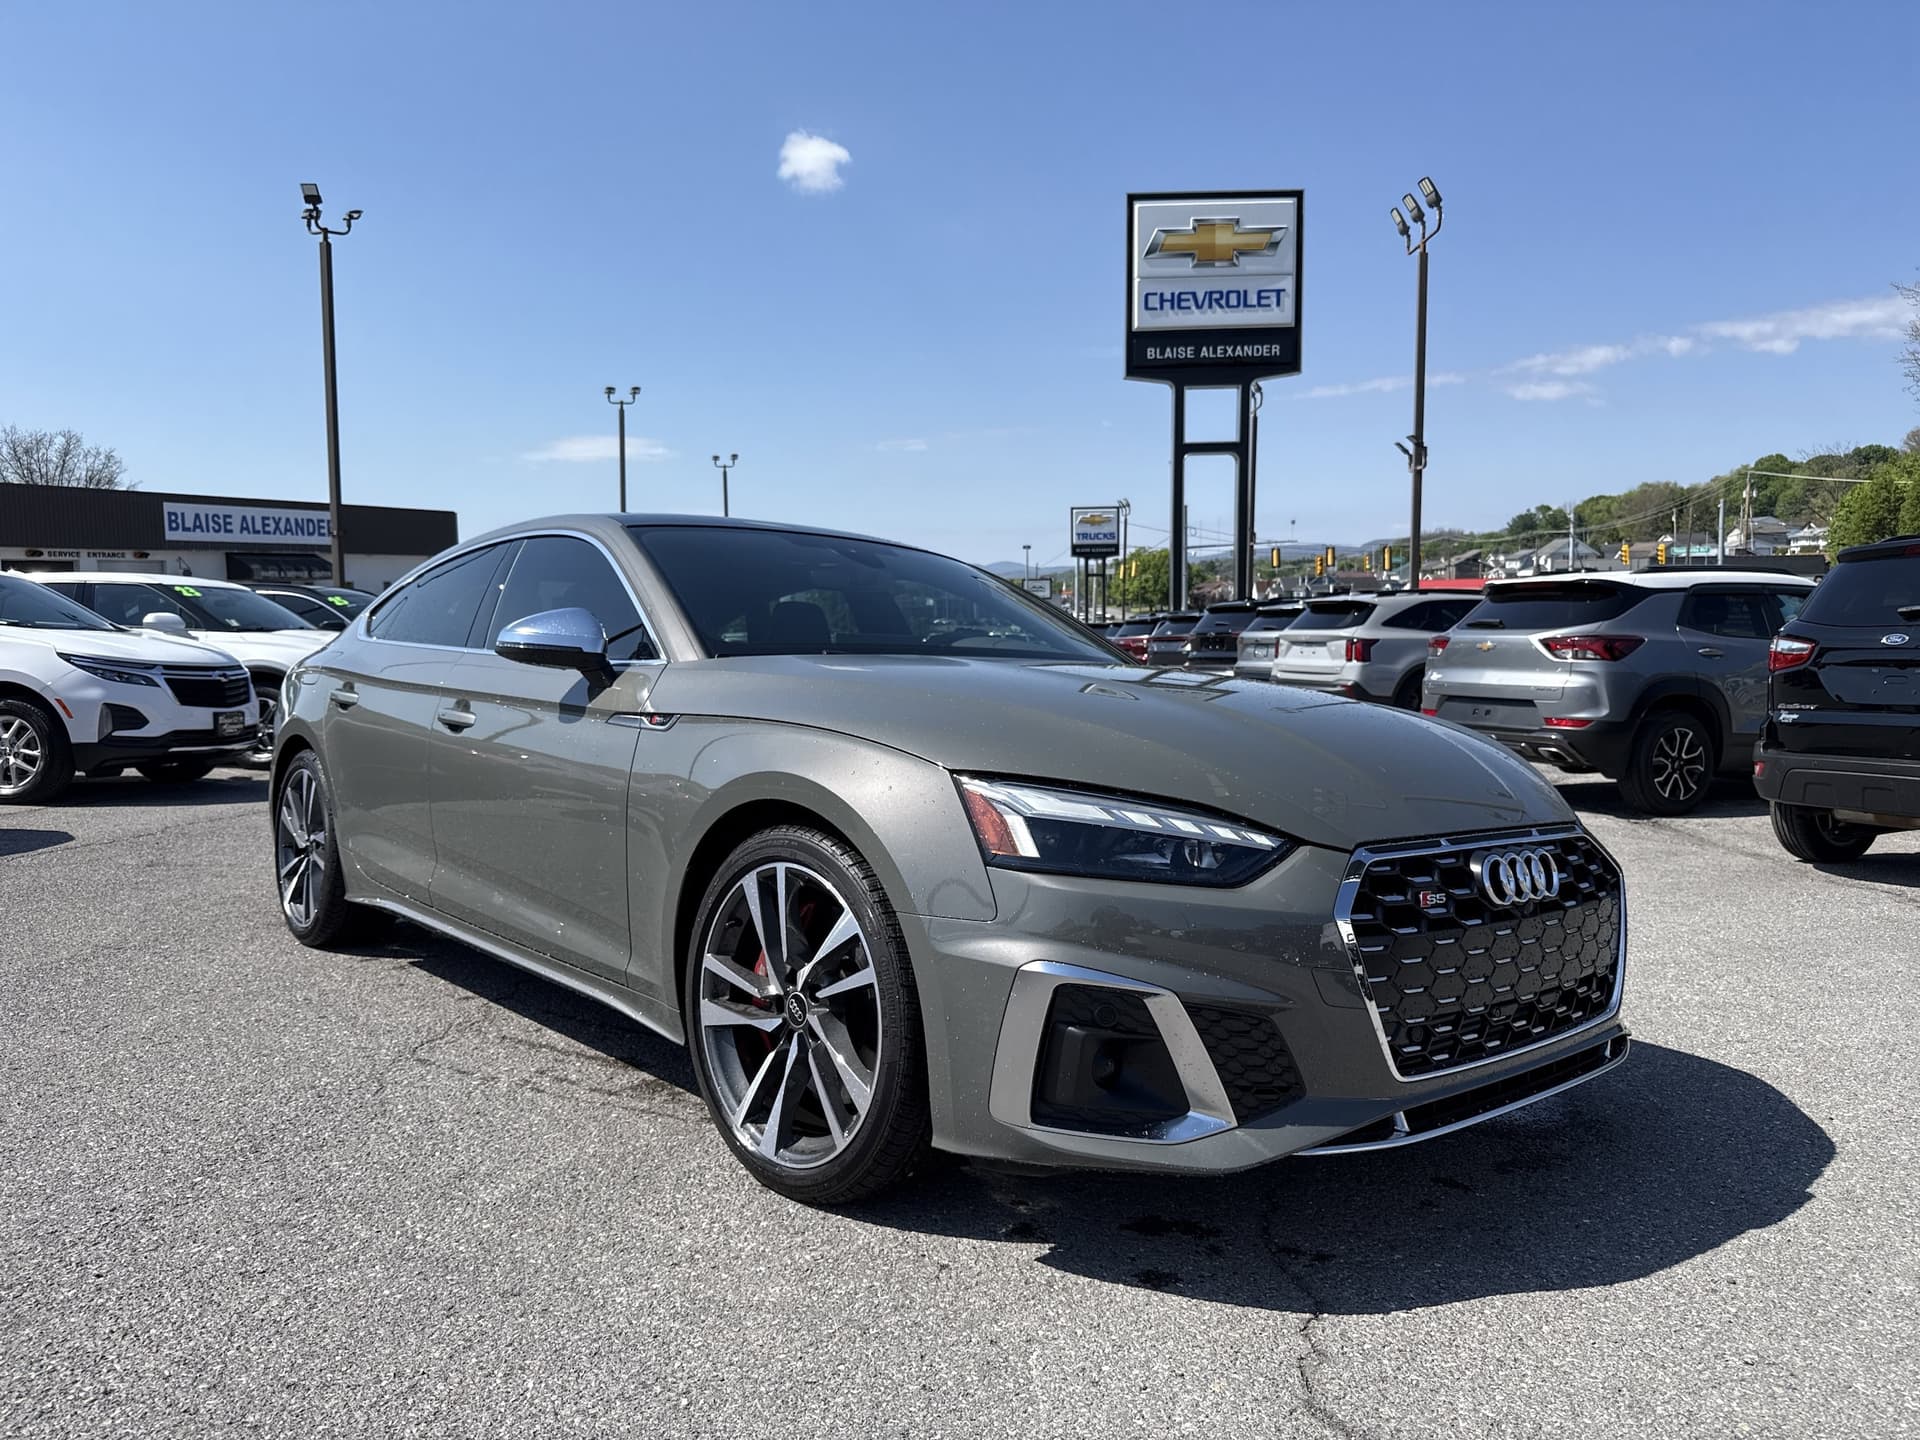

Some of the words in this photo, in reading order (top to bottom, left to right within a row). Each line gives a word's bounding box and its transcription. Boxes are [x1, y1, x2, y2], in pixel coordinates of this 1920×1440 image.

[1143, 289, 1286, 311] CHEVROLET
[1147, 346, 1195, 359] BLAISE
[1200, 344, 1281, 358] ALEXANDER
[167, 511, 234, 534] BLAISE
[1076, 532, 1116, 541] TRUCKS
[47, 550, 80, 558] SERVICE
[87, 551, 125, 559] ENTRANCE
[1426, 893, 1446, 904] S5
